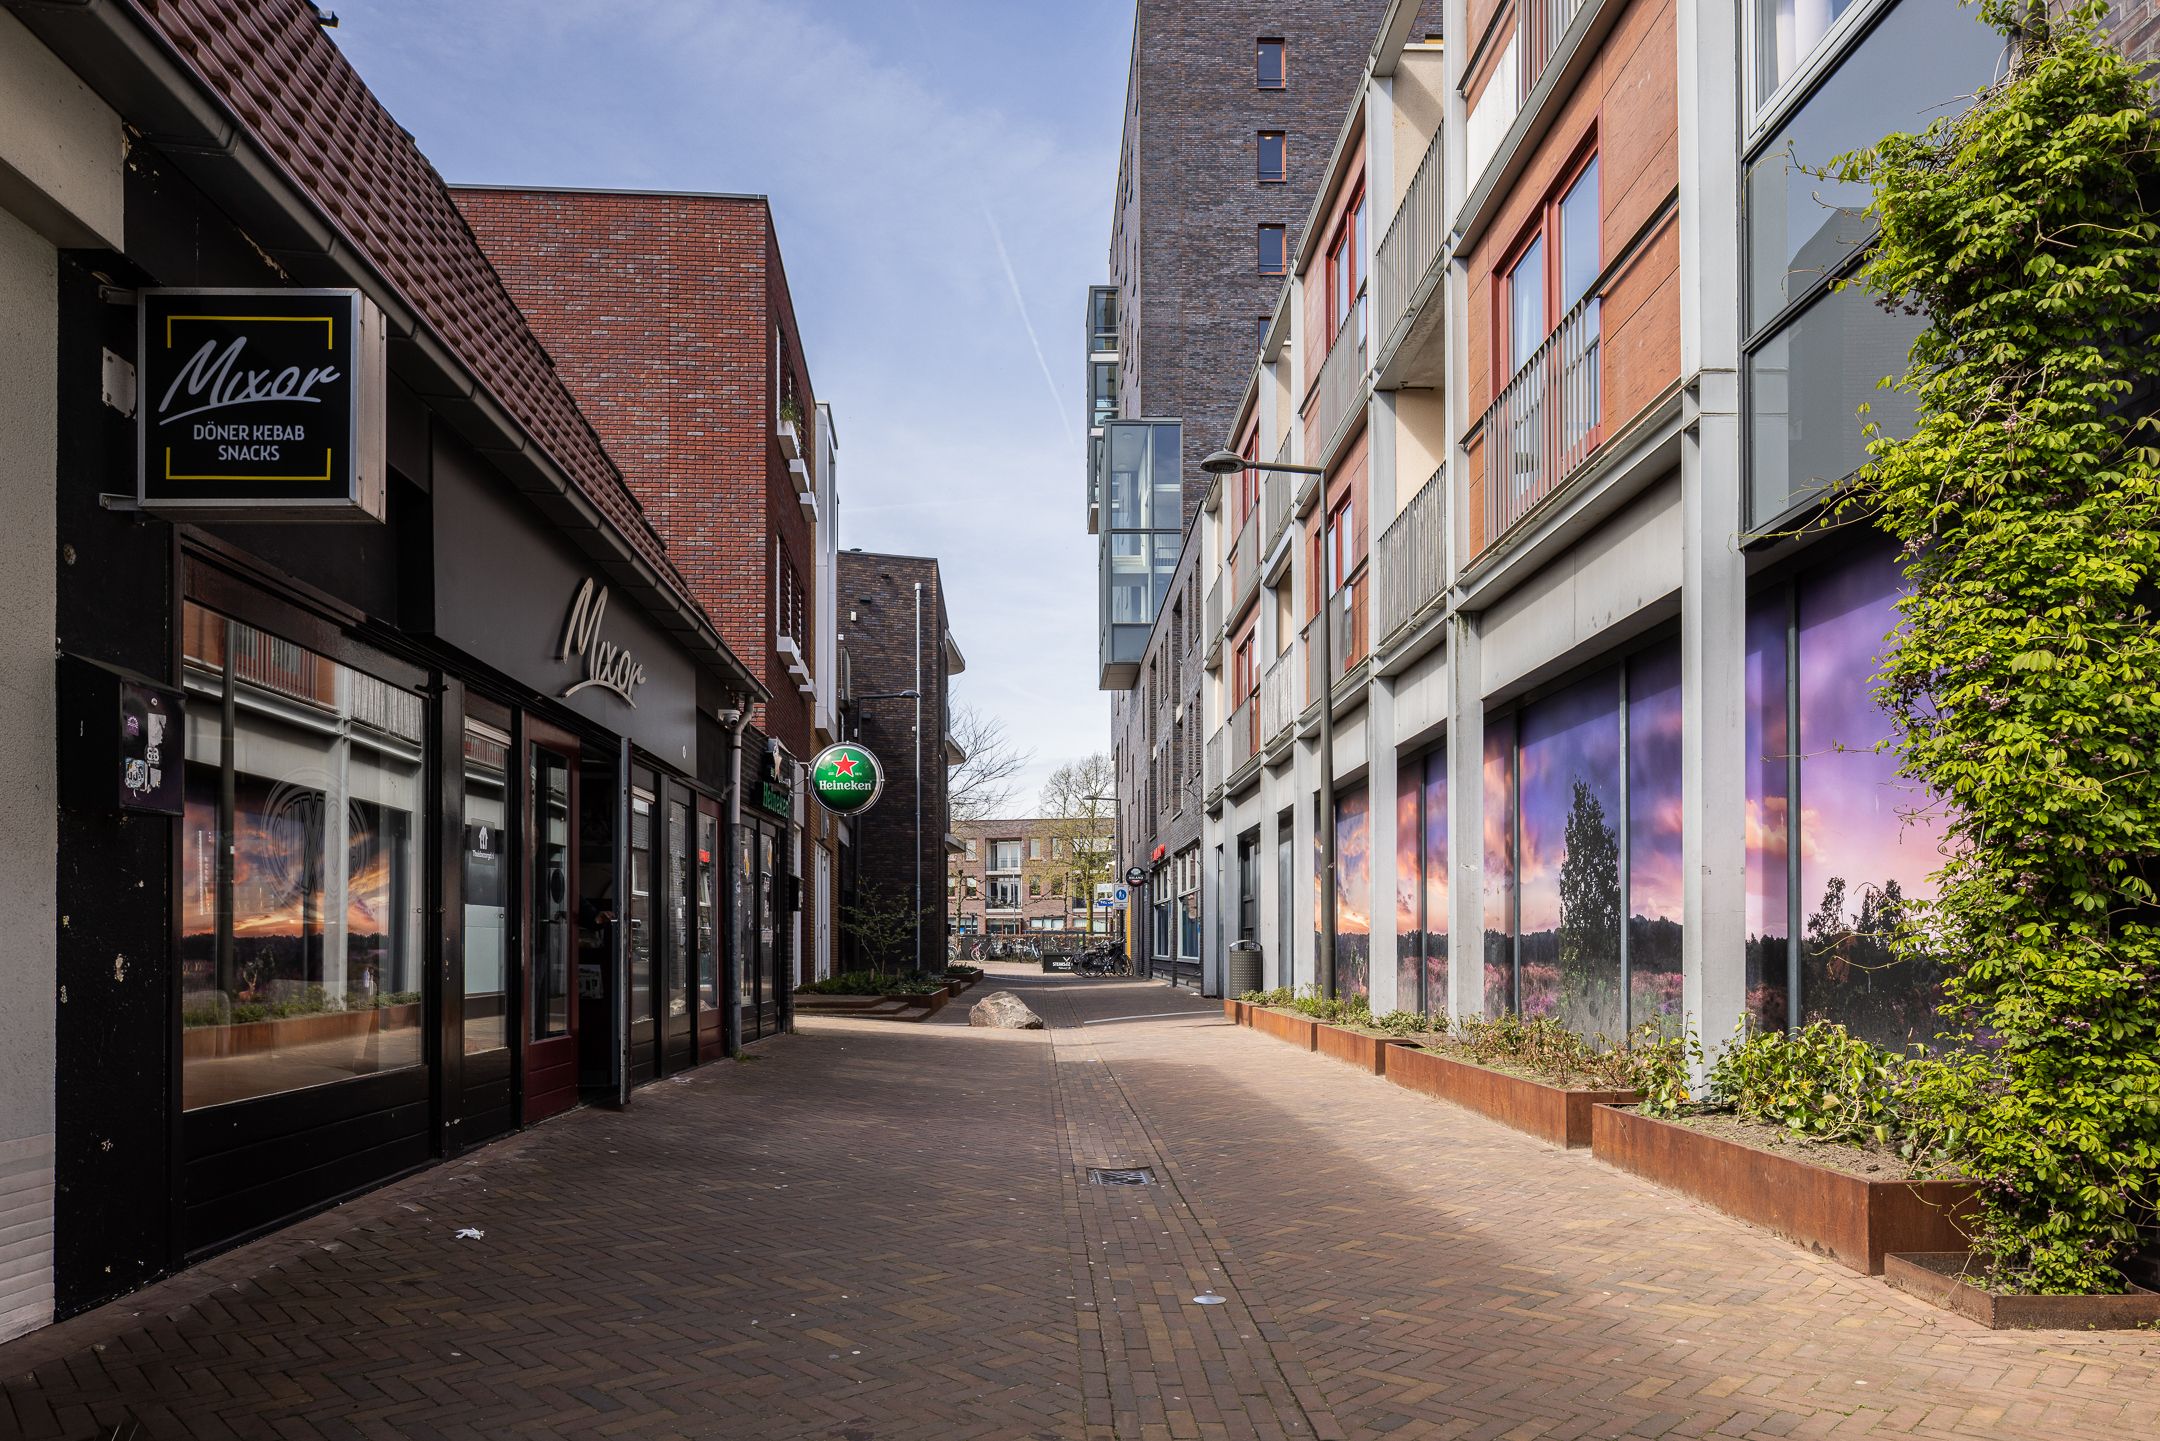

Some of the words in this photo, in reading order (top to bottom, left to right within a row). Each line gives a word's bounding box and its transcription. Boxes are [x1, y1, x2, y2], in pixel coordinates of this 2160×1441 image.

[193, 421, 249, 441] DÖNER
[253, 424, 305, 441] KEBAB
[218, 445, 280, 461] SNACKS
[819, 780, 872, 791] Heineken
